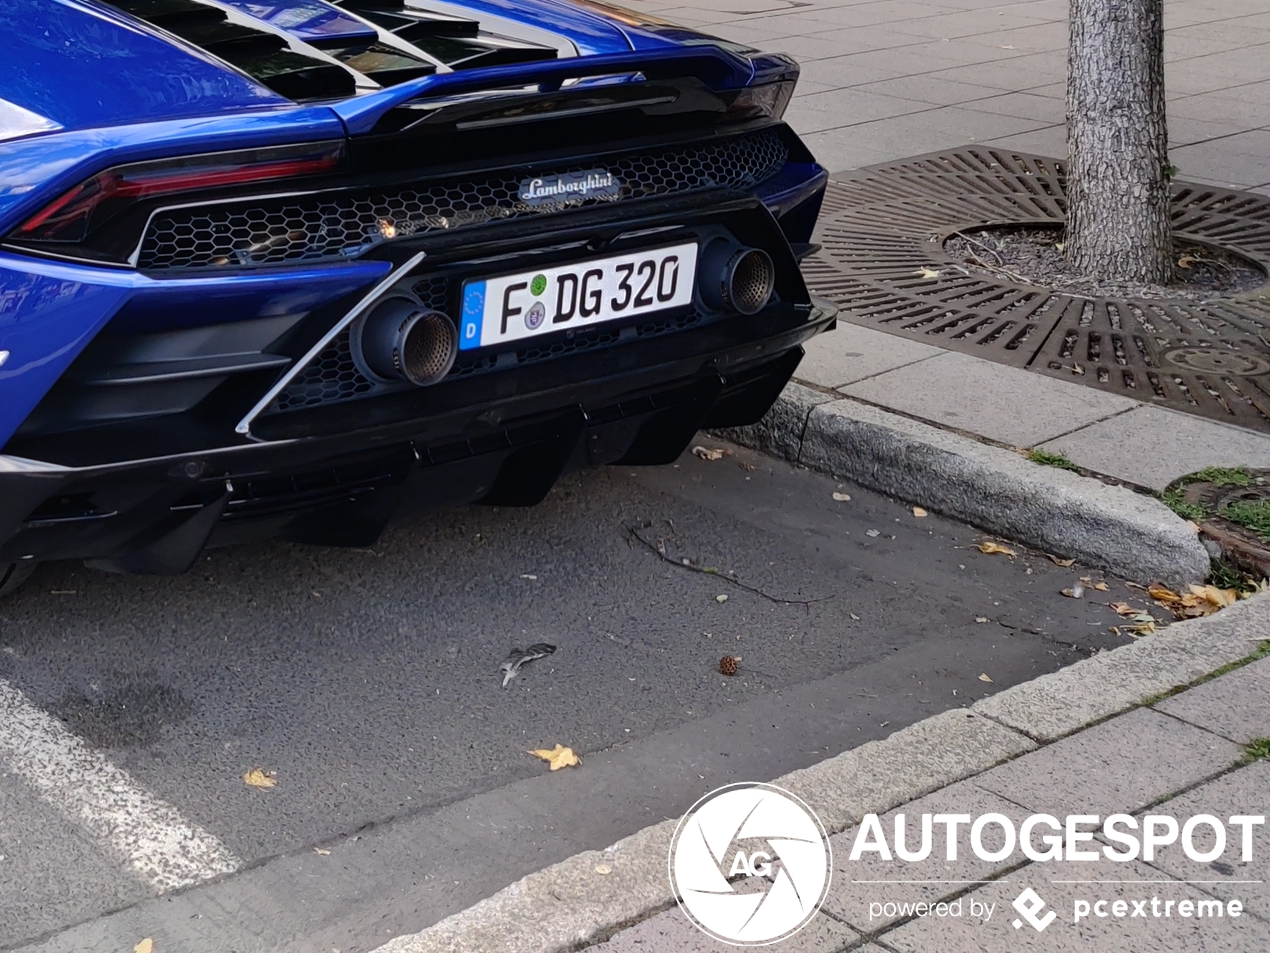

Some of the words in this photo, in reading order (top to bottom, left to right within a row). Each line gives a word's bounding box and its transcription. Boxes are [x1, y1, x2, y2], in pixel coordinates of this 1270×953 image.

[521, 173, 612, 199] Lamborghini
[500, 281, 528, 335] F
[552, 268, 603, 324] DG
[611, 255, 679, 312] 320
[466, 323, 476, 338] D
